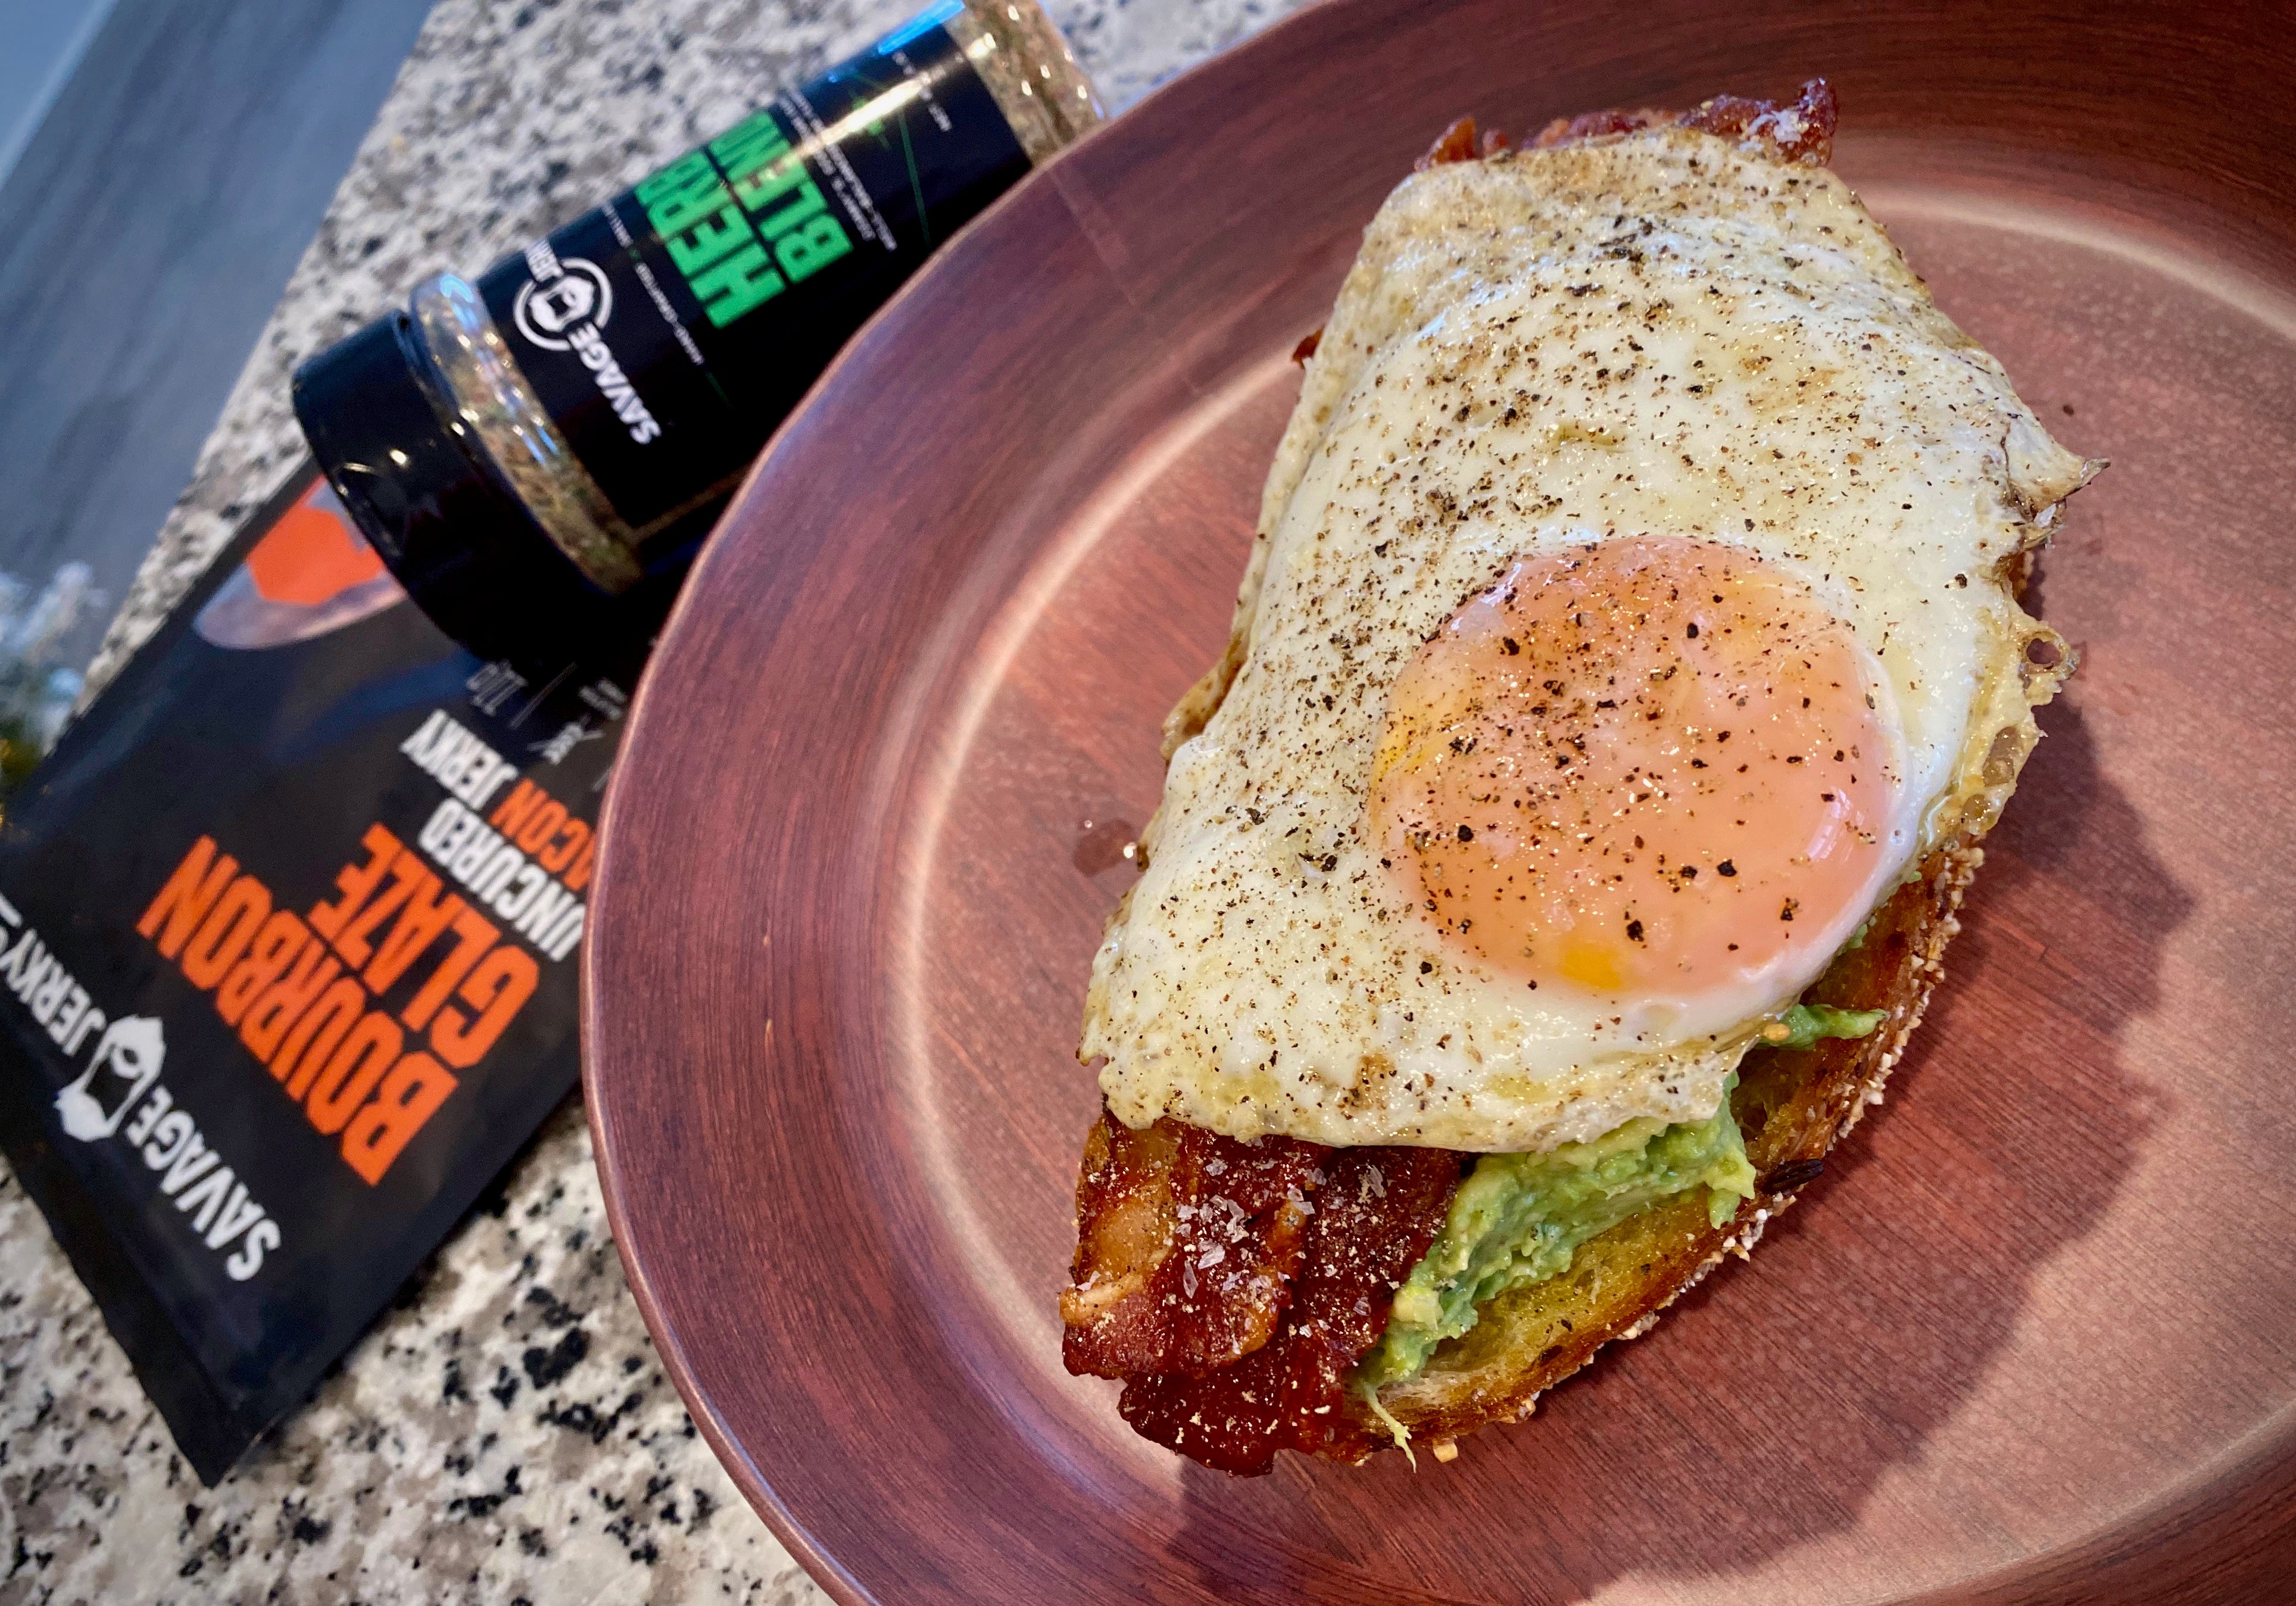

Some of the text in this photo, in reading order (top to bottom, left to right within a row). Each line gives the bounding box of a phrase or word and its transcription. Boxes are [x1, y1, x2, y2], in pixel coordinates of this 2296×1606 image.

[634, 149, 787, 328] HERB
[567, 322, 662, 445] SAVAGE
[399, 709, 595, 891] ACON JERKY
[418, 796, 585, 962] UNCURED
[135, 835, 459, 1186] BOURBON
[307, 822, 539, 1069] GLAZE
[4, 928, 282, 1281] SAVAGE JERKY
